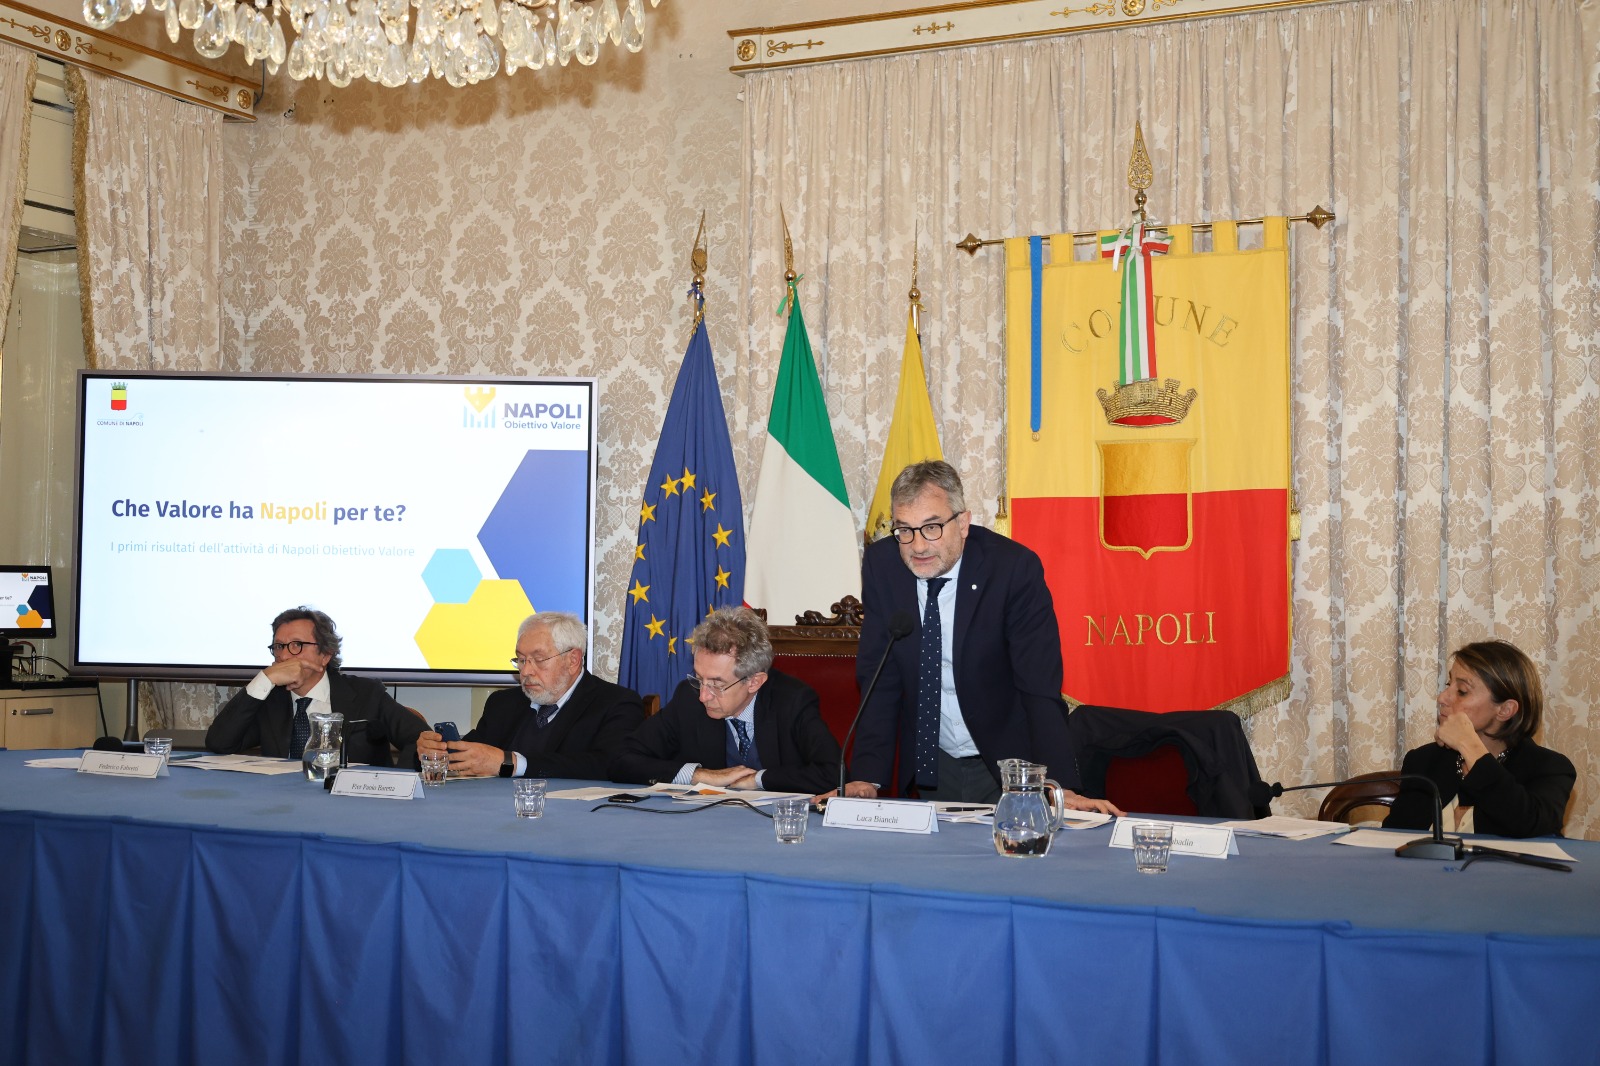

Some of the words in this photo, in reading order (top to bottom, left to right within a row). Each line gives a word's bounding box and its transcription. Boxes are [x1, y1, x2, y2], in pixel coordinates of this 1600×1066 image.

[1061, 295, 1239, 354] COUNE
[504, 402, 582, 419] NAPOLI
[504, 420, 548, 429] Obiettivo
[551, 421, 581, 430] Valore
[111, 498, 150, 517] Che
[155, 499, 223, 519] Valore
[229, 500, 254, 519] ha
[260, 501, 327, 525] Napoli
[333, 506, 369, 525] per
[373, 504, 407, 522] te?
[117, 541, 148, 554] primi
[151, 541, 196, 553] risultati
[199, 542, 264, 554] dell'attività
[267, 544, 278, 554] di
[282, 544, 319, 557] Napoli
[322, 544, 375, 556] Obiettivo
[378, 546, 415, 557] Valore
[1083, 611, 1217, 646] NAPOLI
[856, 814, 873, 822] Luca
[873, 815, 899, 824] Bianchi
